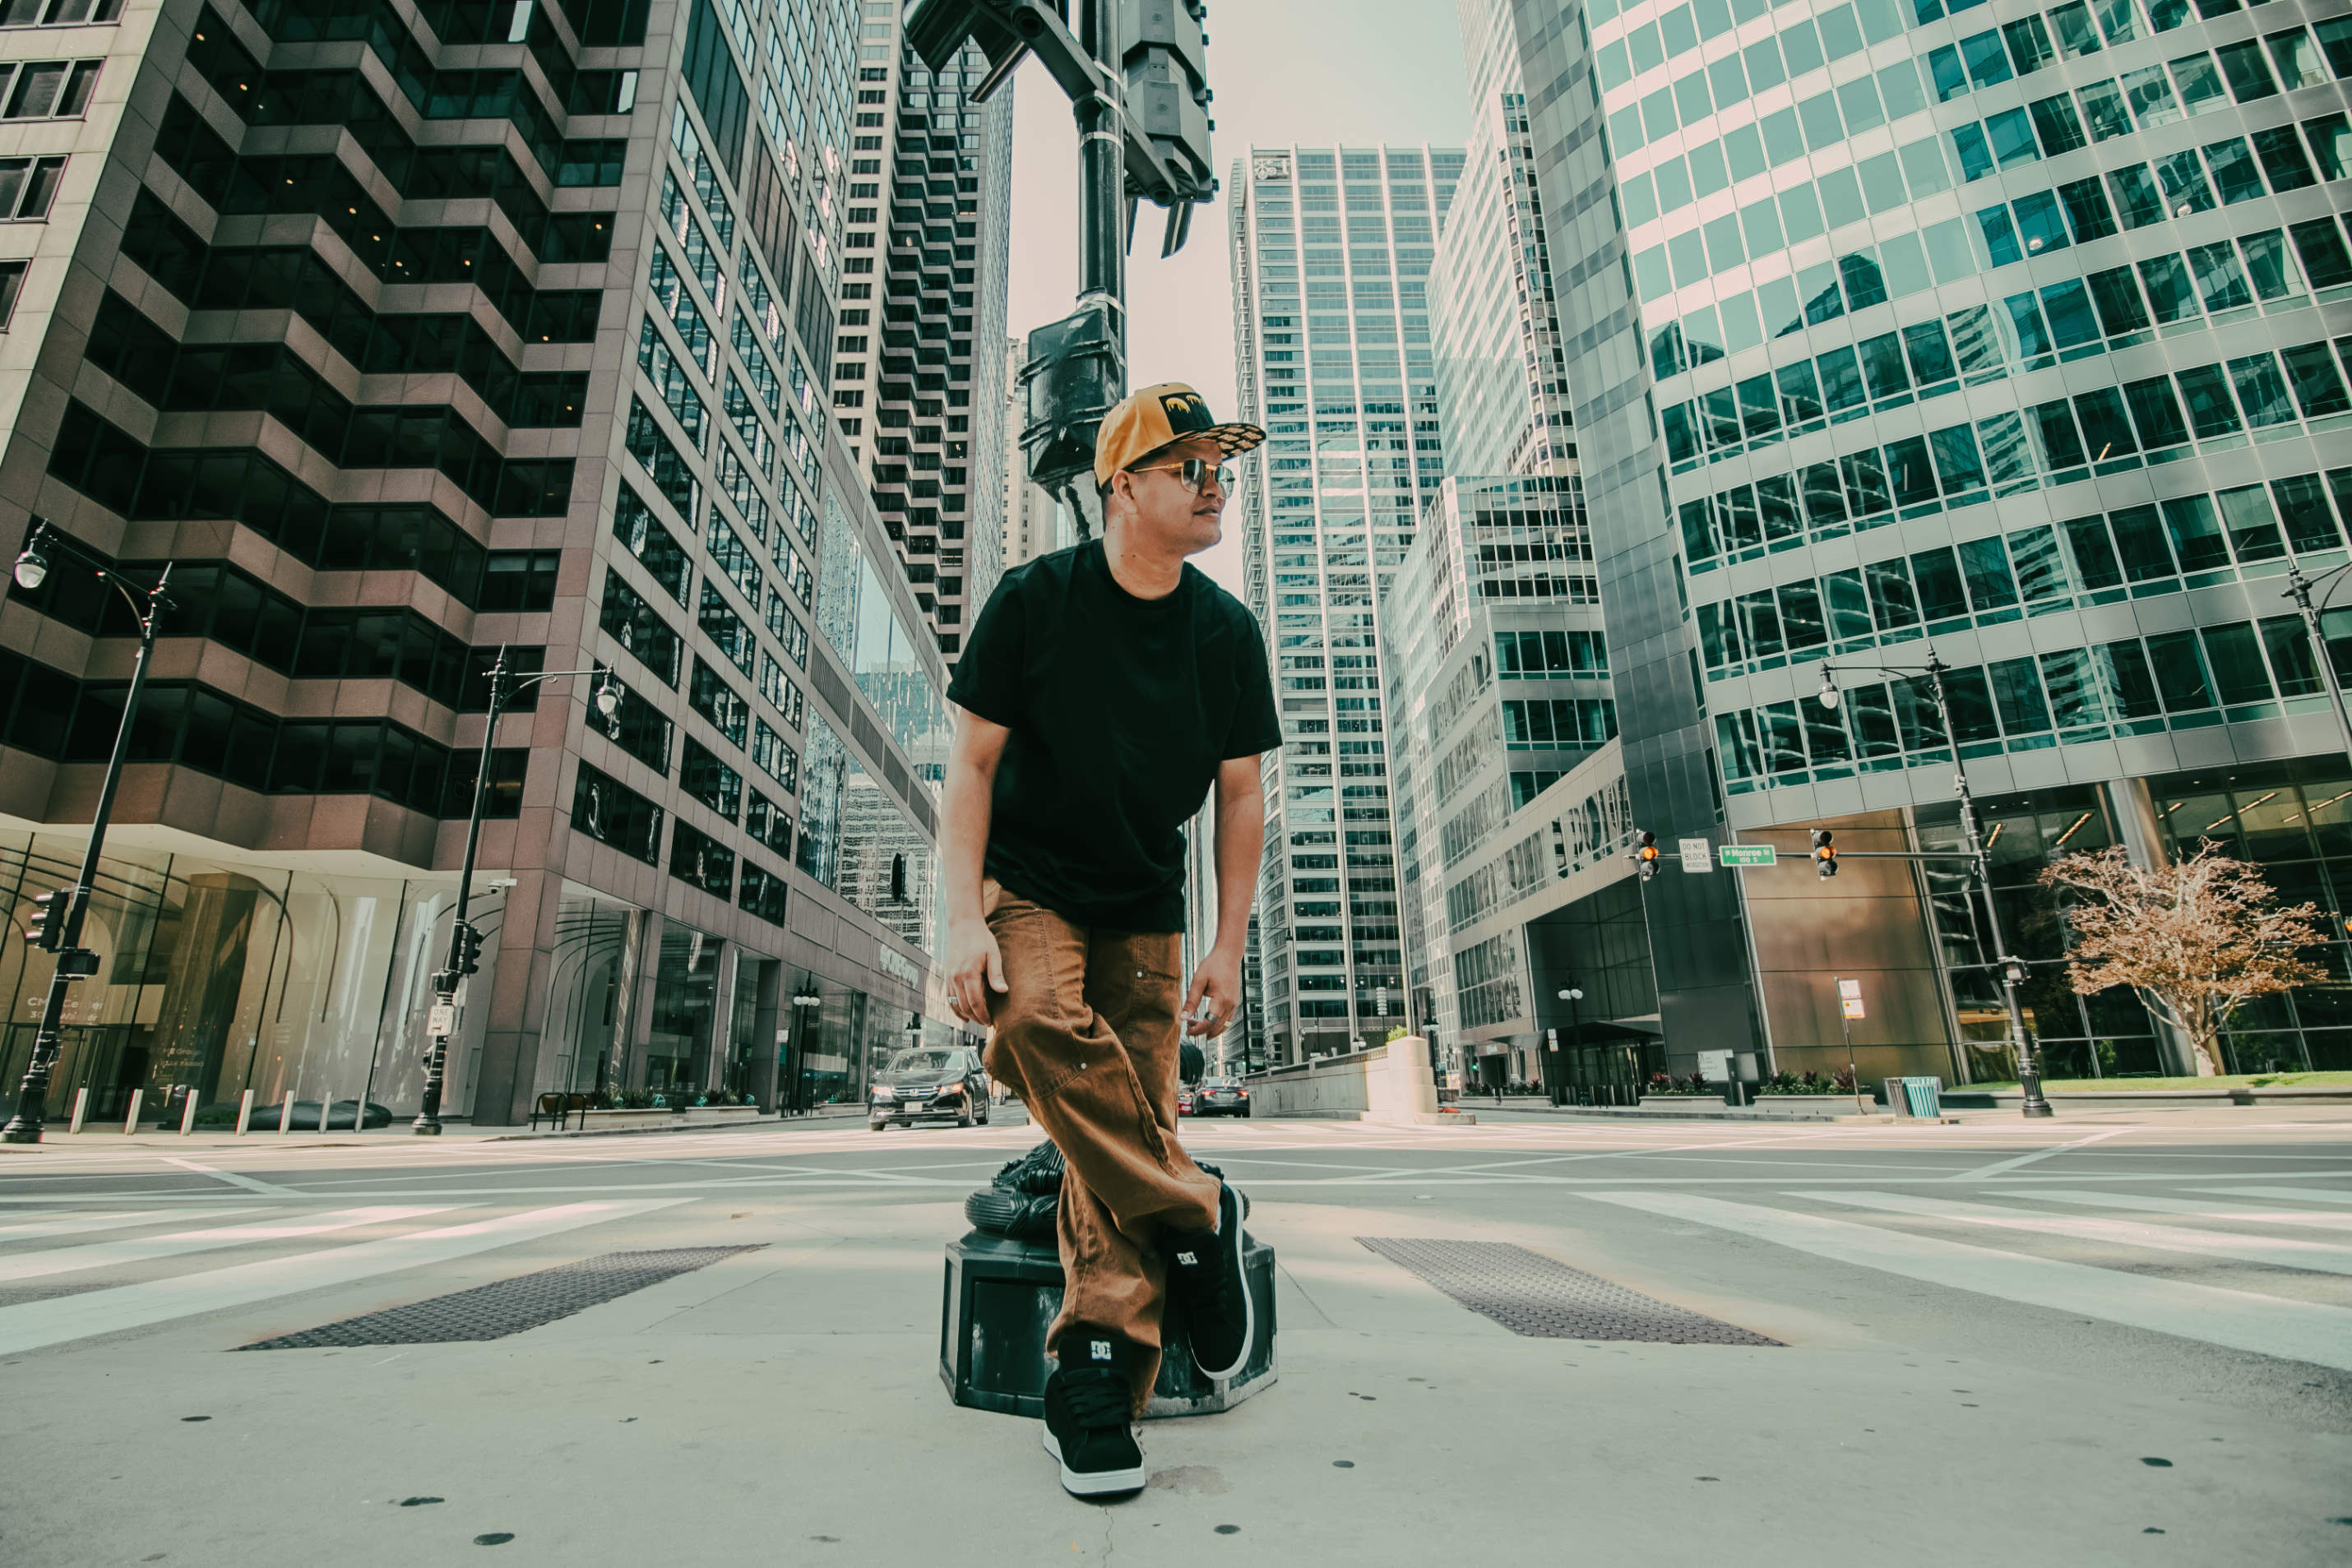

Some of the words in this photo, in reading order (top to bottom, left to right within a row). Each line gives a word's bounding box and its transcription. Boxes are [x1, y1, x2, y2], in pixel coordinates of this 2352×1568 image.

[1692, 842, 1705, 850] NOT
[1684, 852, 1707, 861] BLOCK
[1731, 848, 1762, 857] Monroe
[27, 997, 48, 1006] CM
